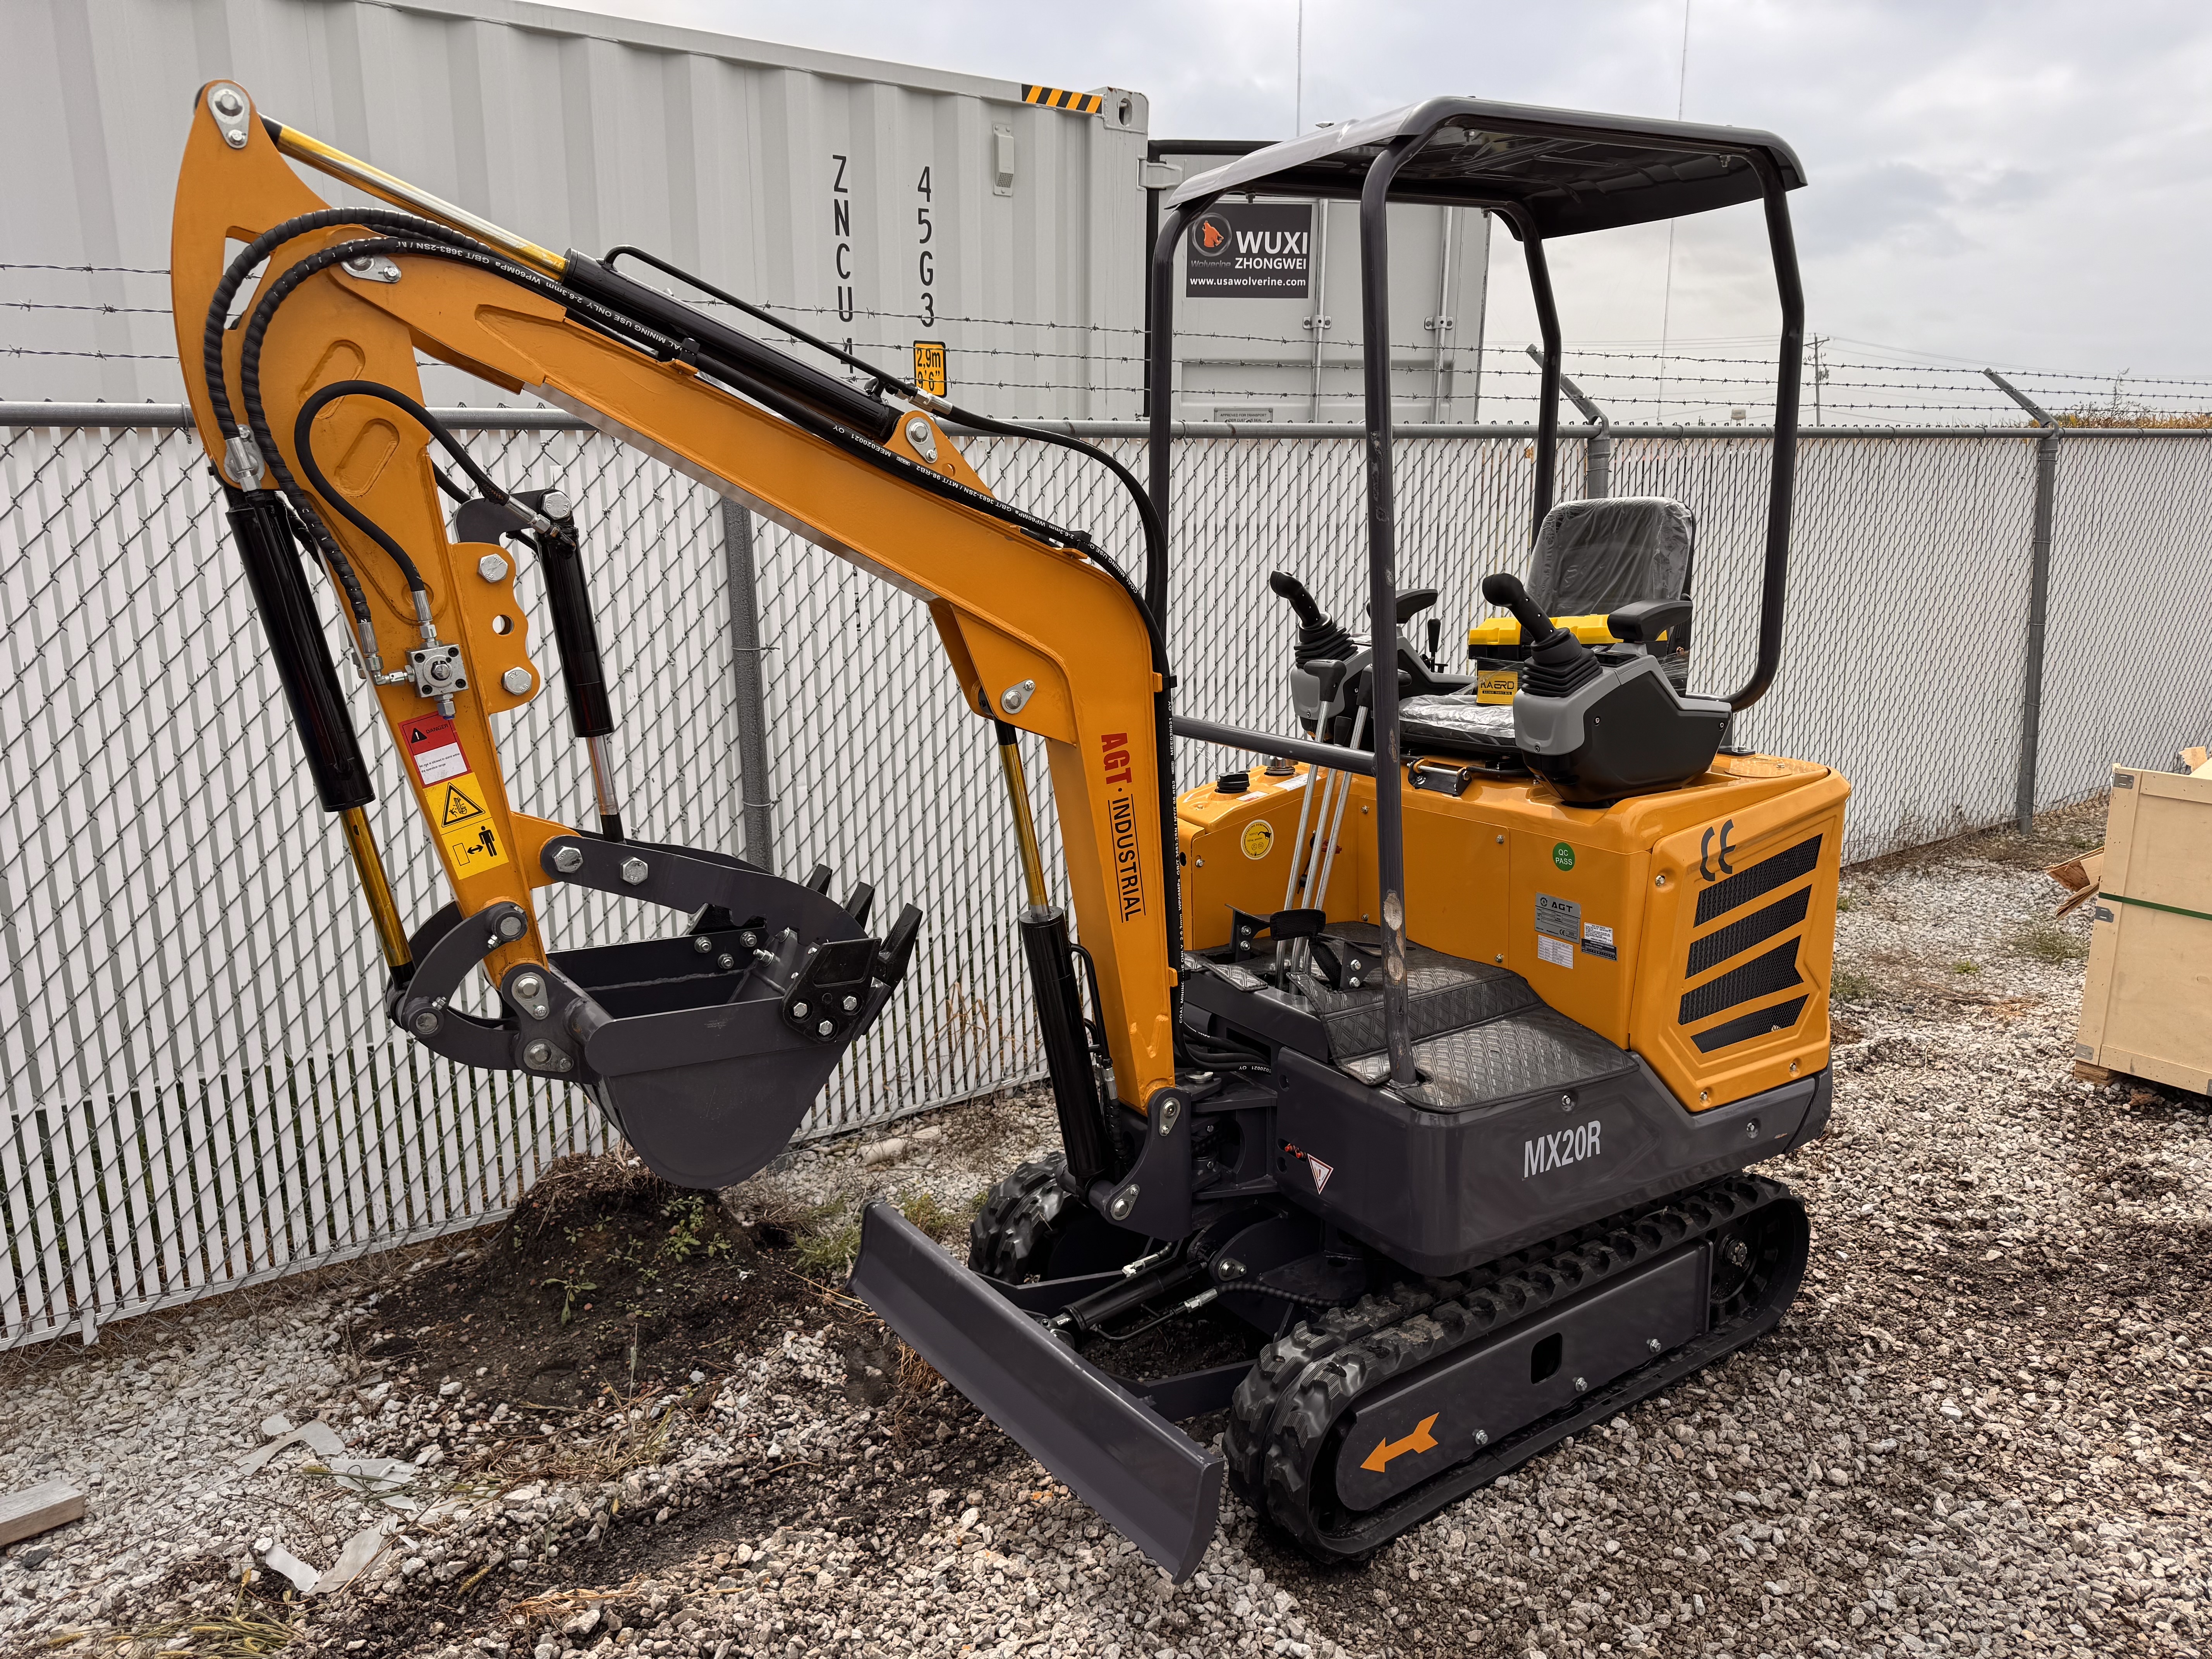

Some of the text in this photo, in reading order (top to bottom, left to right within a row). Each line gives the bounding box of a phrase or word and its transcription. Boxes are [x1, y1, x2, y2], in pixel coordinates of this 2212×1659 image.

[833, 154, 853, 323] ZNCU
[1236, 231, 1308, 254] WUXI
[416, 242, 463, 256] 3683-2SN
[917, 166, 934, 327] 45G3
[465, 252, 489, 264] GB/T
[1191, 260, 1231, 268] Wolverine
[1235, 258, 1306, 270] ZHONGWEI
[495, 261, 541, 285] WP60MPa
[1190, 276, 1306, 286] www.usawolverine.com
[546, 282, 583, 303] 2-6.3mm
[586, 302, 611, 317] ONLY
[614, 314, 632, 327] USE
[634, 325, 666, 344] MINING
[851, 433, 891, 457] MEE020021
[916, 465, 941, 480] 98-RB2
[941, 478, 958, 488] MT/T
[964, 487, 994, 505] 3683-2SN
[995, 502, 1012, 512] GB/T
[1095, 548, 1108, 559] USE
[1108, 559, 1126, 578] MINING
[1126, 576, 1138, 593] COAL
[426, 724, 448, 733] DANGER
[1101, 733, 1142, 922] AGT INDUSTRIAL
[1556, 857, 1573, 866] PASS
[1552, 902, 1573, 912] AGT
[1523, 1120, 1601, 1179] MX20R
